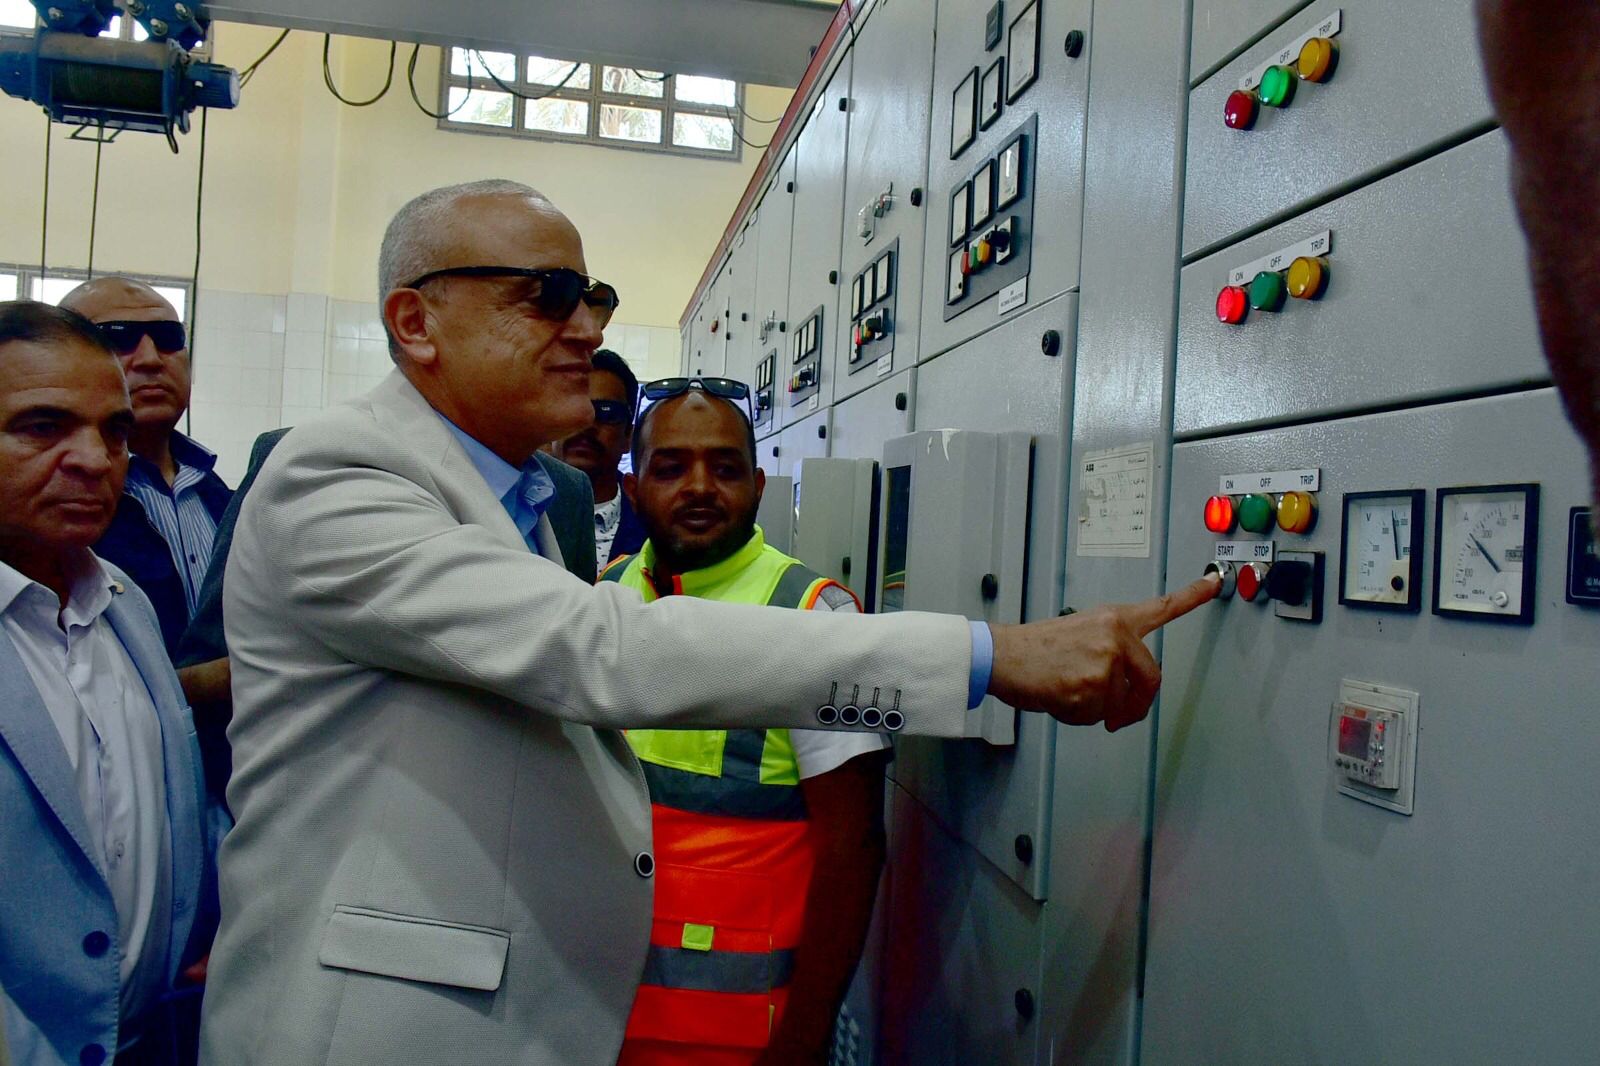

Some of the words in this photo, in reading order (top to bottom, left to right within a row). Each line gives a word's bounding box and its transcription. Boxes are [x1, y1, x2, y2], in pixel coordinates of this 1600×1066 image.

[1244, 77, 1253, 88] ON
[1279, 50, 1290, 64] OFF
[1318, 21, 1332, 37] TRIP
[1235, 272, 1244, 282] ON
[1270, 255, 1282, 268] OFF
[1311, 238, 1325, 252] TRIP
[1225, 480, 1234, 489] ON
[1260, 477, 1272, 488] OFF
[1300, 475, 1314, 486] TRIP
[1217, 545, 1234, 556] START
[1254, 545, 1269, 557] STOP
